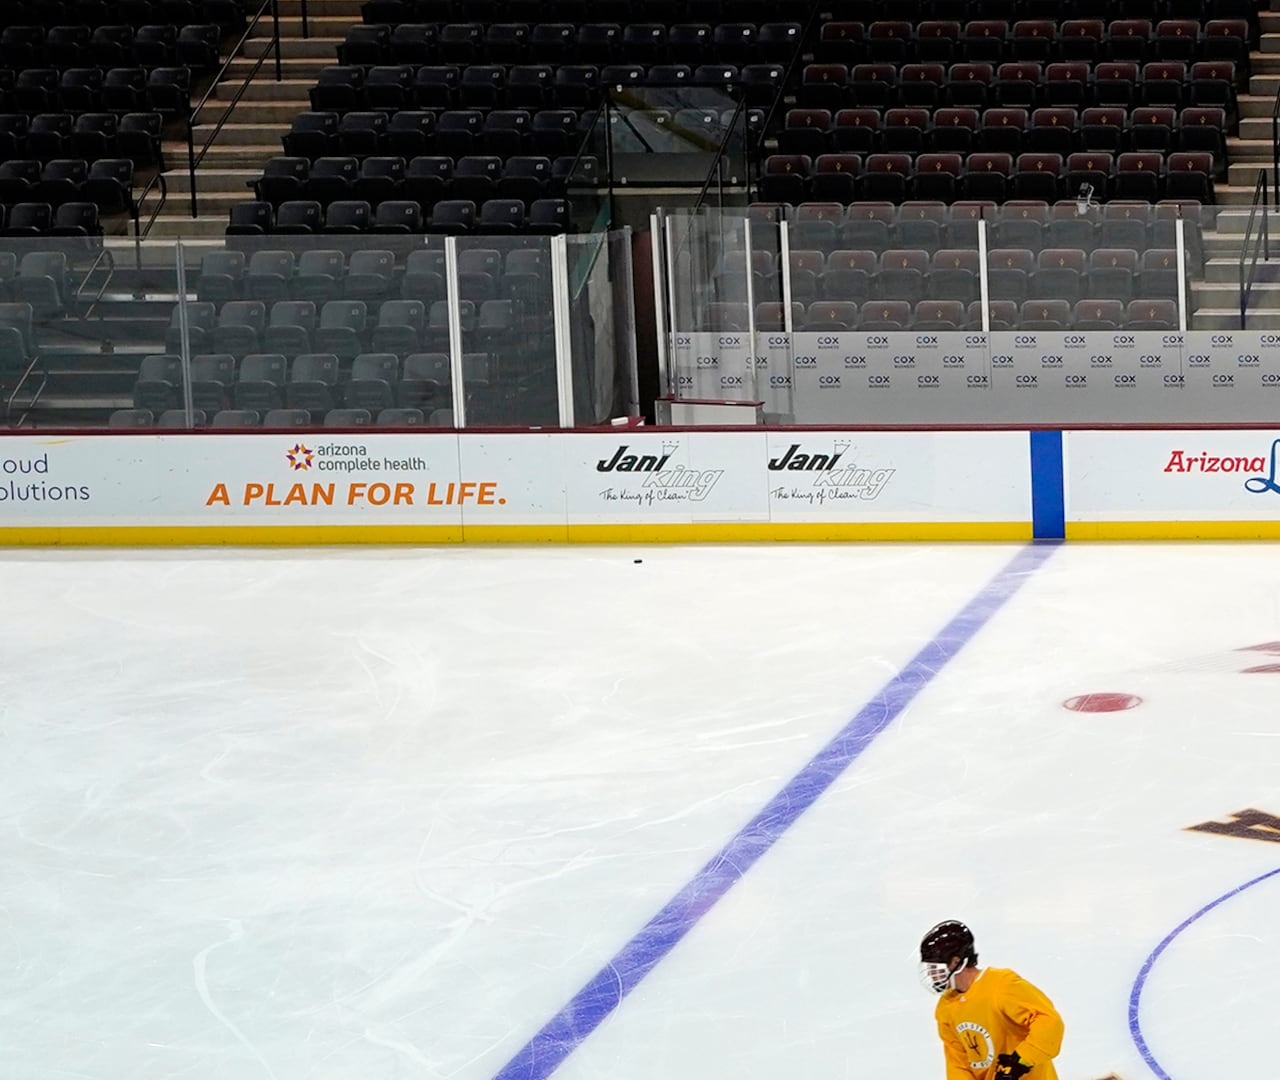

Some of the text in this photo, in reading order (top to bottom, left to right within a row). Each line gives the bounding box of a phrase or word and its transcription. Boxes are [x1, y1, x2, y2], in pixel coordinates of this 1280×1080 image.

[769, 336, 790, 345] COX
[819, 336, 840, 345] COX
[967, 335, 987, 345] COX
[1016, 335, 1037, 344] COX
[1065, 335, 1086, 344] COX
[1213, 335, 1233, 344] COX
[698, 356, 721, 365] COX
[846, 355, 866, 365] COX
[895, 355, 916, 365] COX
[1092, 355, 1113, 364] COX
[1141, 355, 1162, 364] COX
[1239, 354, 1260, 363] COX
[721, 376, 743, 385] COX
[870, 375, 891, 384] COX
[919, 375, 940, 384] COX
[1017, 375, 1038, 384] COX
[1115, 374, 1137, 384] COX
[1165, 374, 1185, 383] COX
[317, 442, 367, 456] arizona
[597, 445, 671, 472] Jani
[768, 444, 842, 471] Jani
[1164, 450, 1266, 474] Arizona
[318, 458, 381, 472] complete
[207, 482, 506, 505] A PLAN FOR LIFE.
[600, 488, 619, 501] The
[771, 487, 789, 500] The
